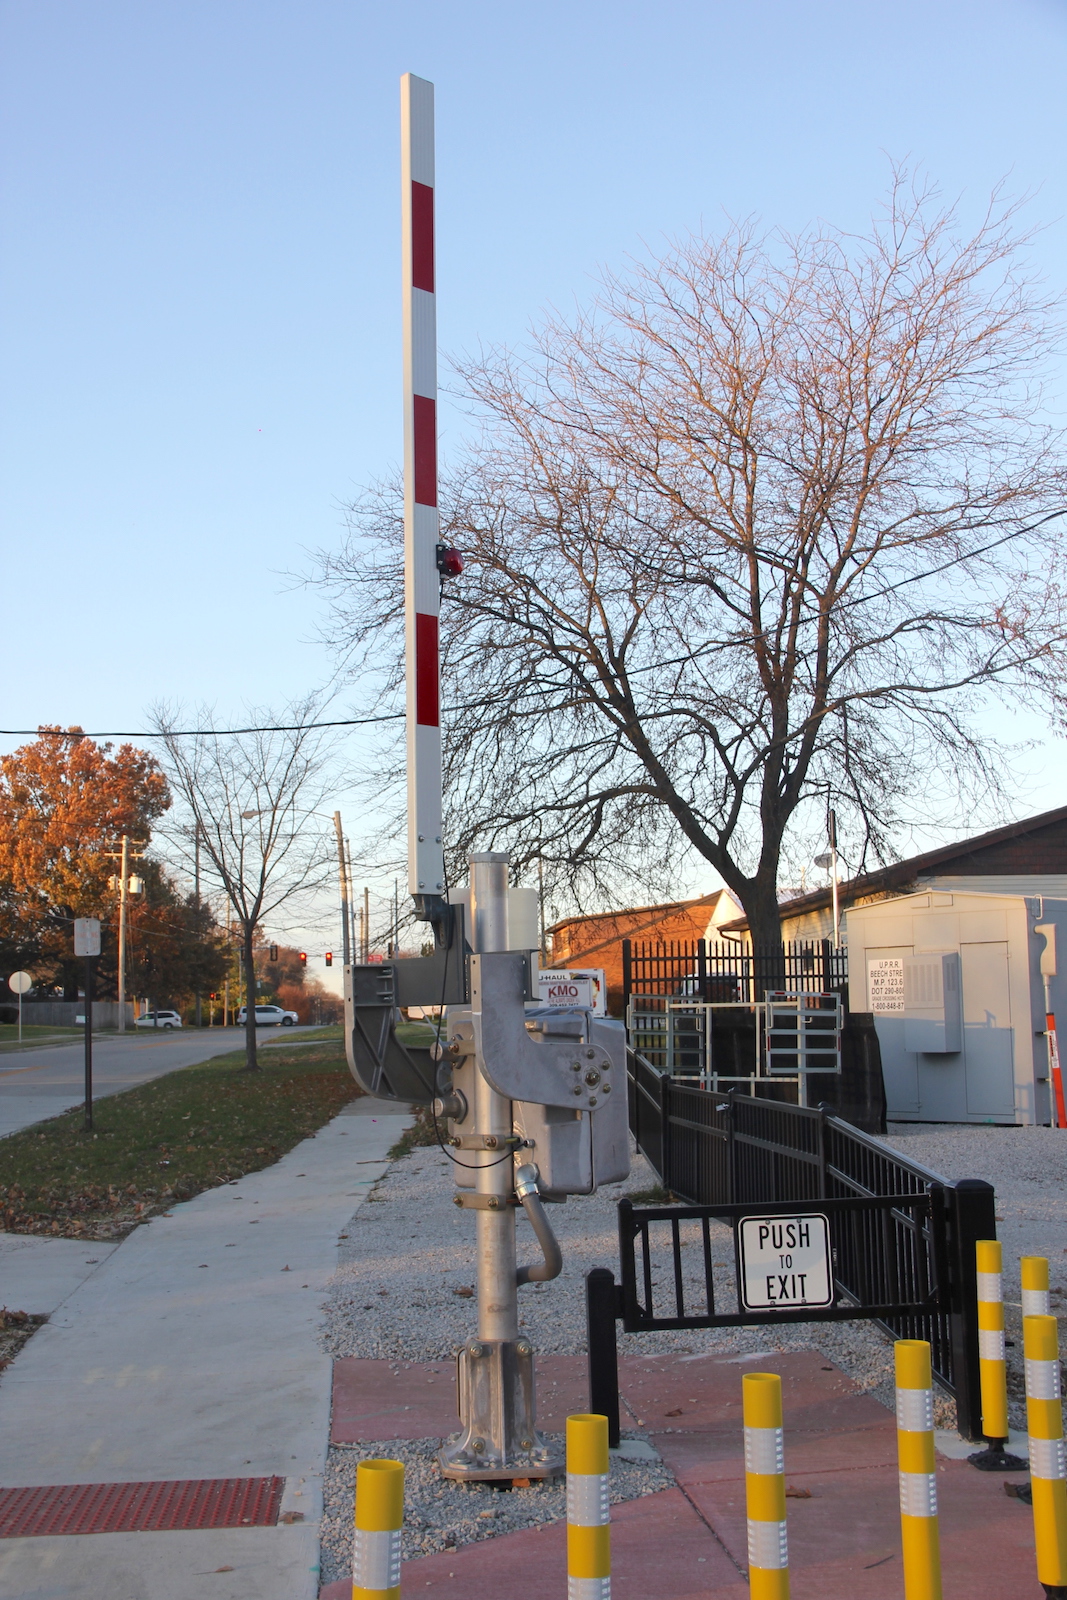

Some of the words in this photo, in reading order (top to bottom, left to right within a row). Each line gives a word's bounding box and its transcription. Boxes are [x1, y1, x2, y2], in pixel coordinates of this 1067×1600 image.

[870, 970, 888, 978] BEECH
[548, 985, 578, 998] KMO
[871, 987, 883, 995] DOT
[759, 1223, 810, 1250] PUSH
[779, 1254, 793, 1269] TO
[766, 1273, 807, 1300] EXIT
